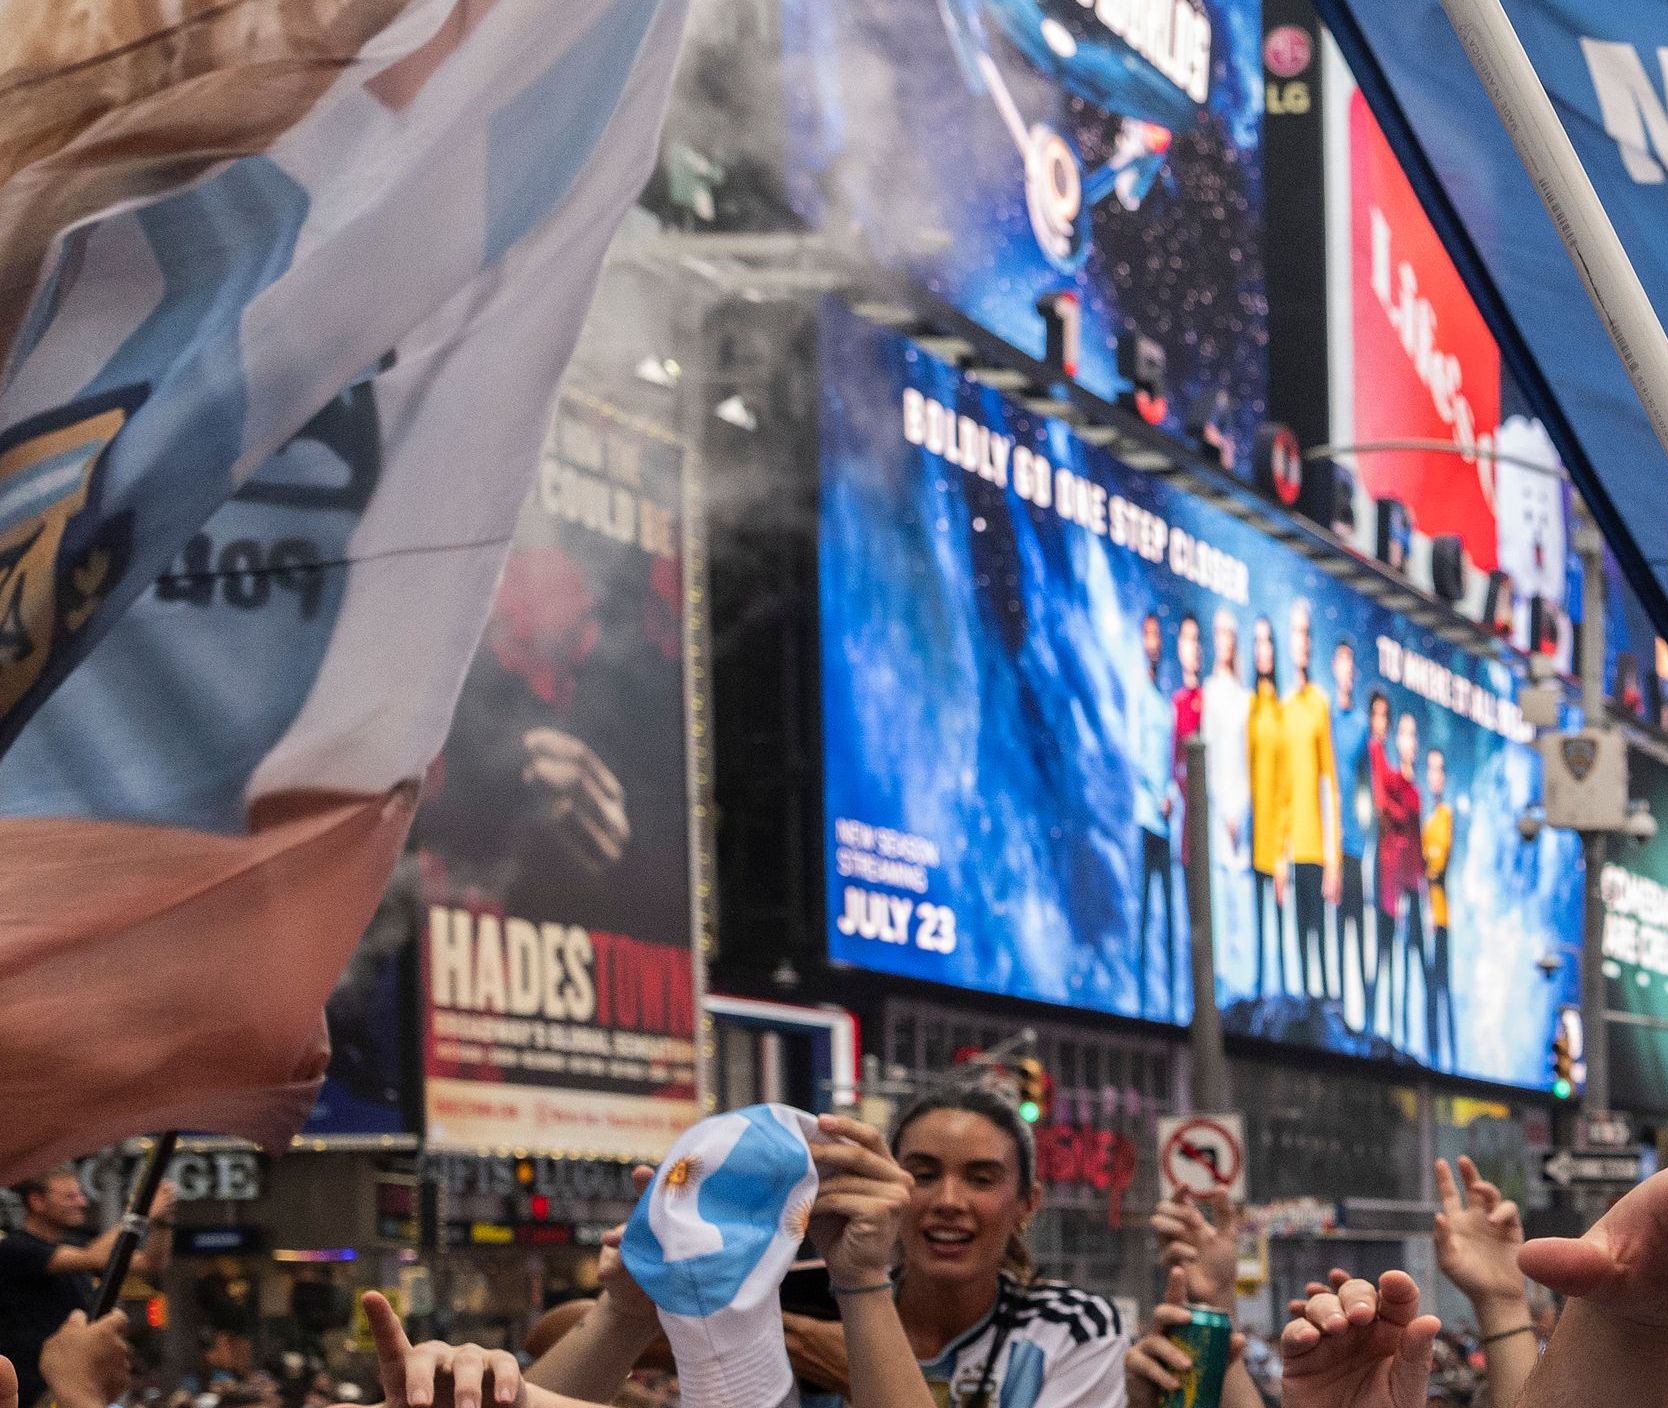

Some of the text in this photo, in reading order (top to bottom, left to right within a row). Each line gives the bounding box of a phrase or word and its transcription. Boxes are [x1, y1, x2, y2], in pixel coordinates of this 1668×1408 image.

[903, 386, 1011, 490] BOLDLY
[837, 885, 958, 956] JULY 23
